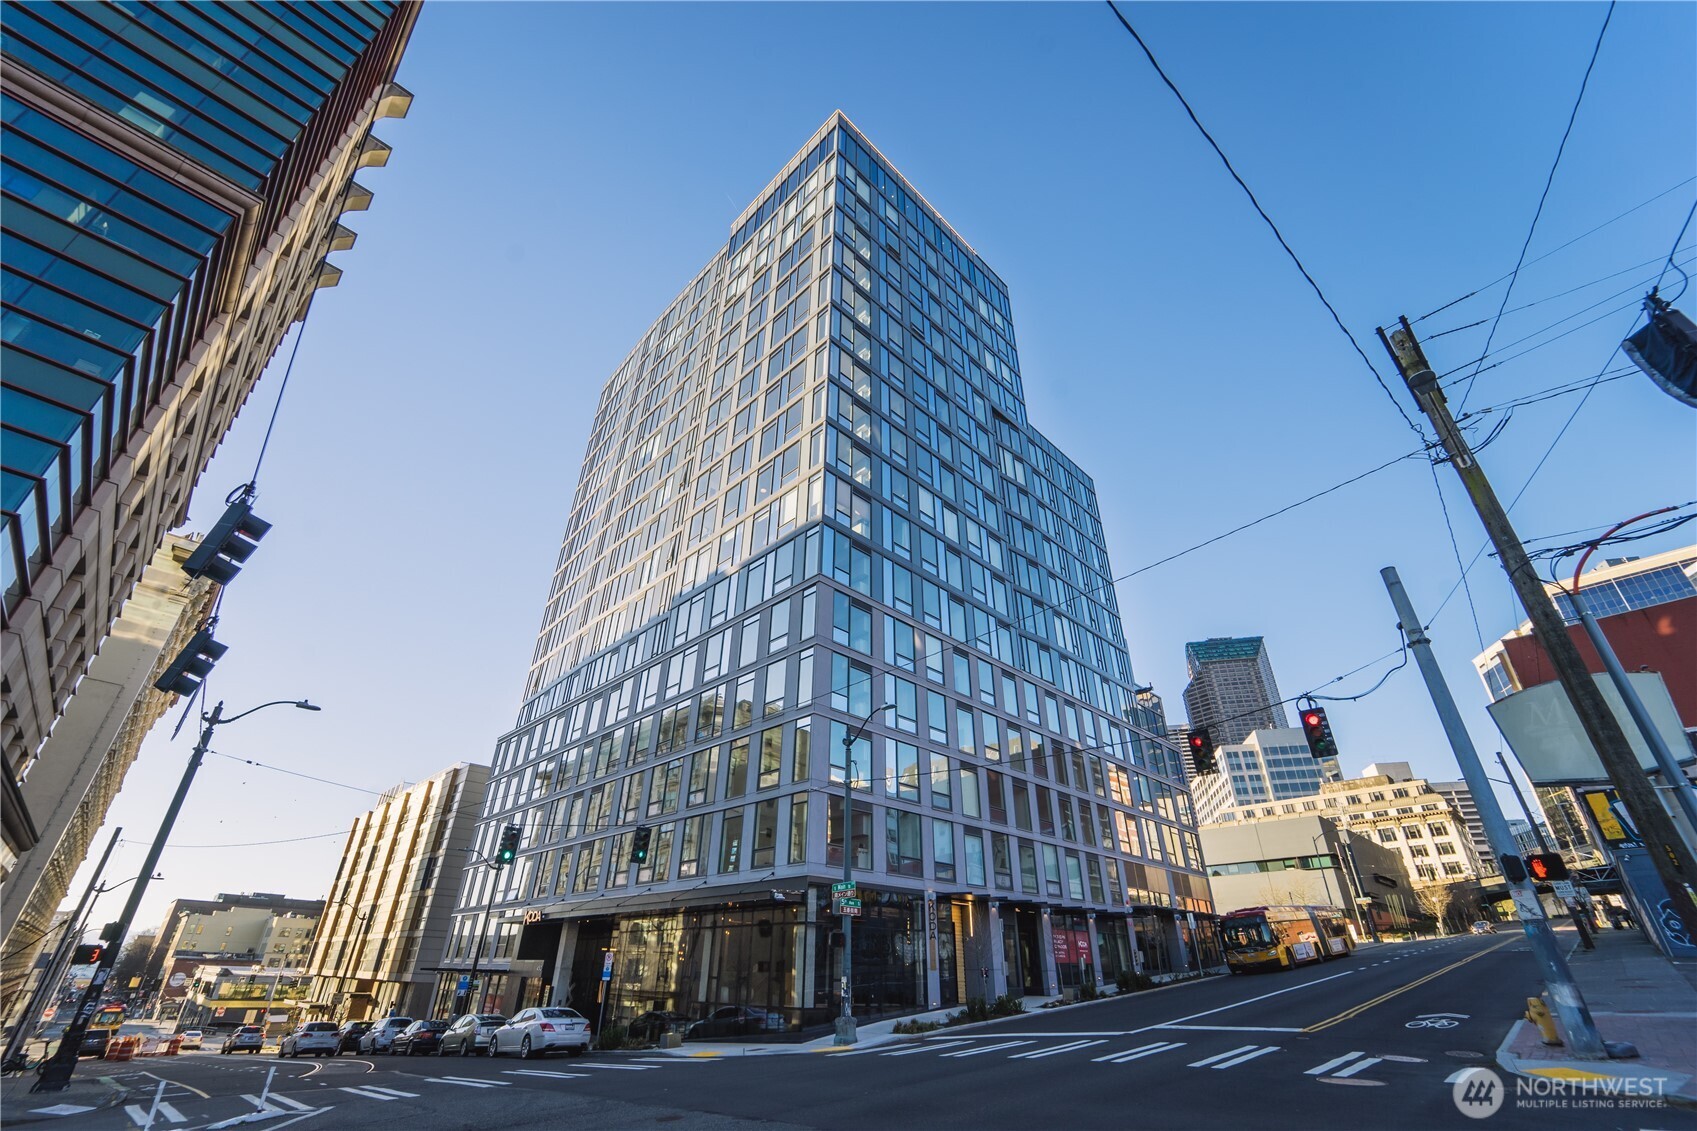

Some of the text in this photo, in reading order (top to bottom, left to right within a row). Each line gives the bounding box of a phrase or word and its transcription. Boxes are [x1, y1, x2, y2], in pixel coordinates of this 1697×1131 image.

[523, 910, 541, 924] KODA
[928, 899, 936, 940] KODA
[90, 949, 99, 962] 3
